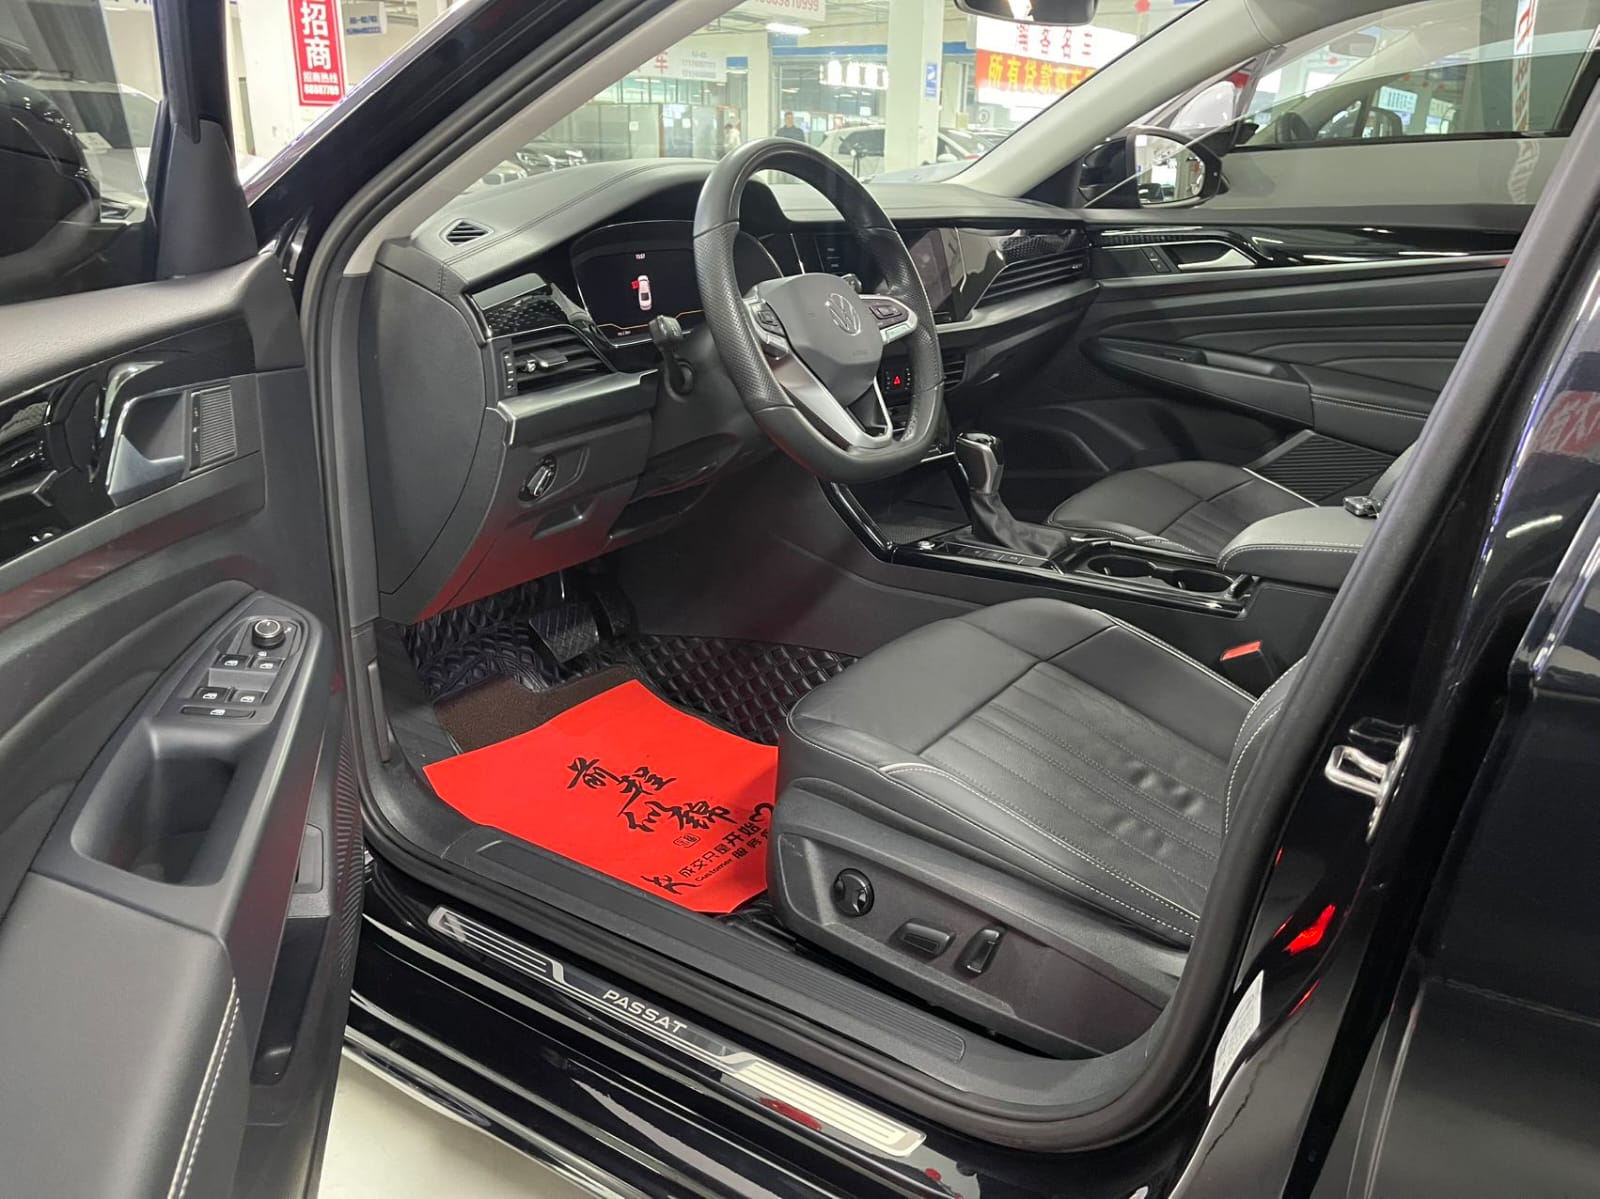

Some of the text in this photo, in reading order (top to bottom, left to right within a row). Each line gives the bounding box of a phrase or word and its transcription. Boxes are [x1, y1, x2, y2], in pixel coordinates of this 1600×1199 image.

[301, 0, 331, 70] 招商
[679, 821, 760, 878] 成交只是开始
[602, 989, 687, 1033] PASSAT
